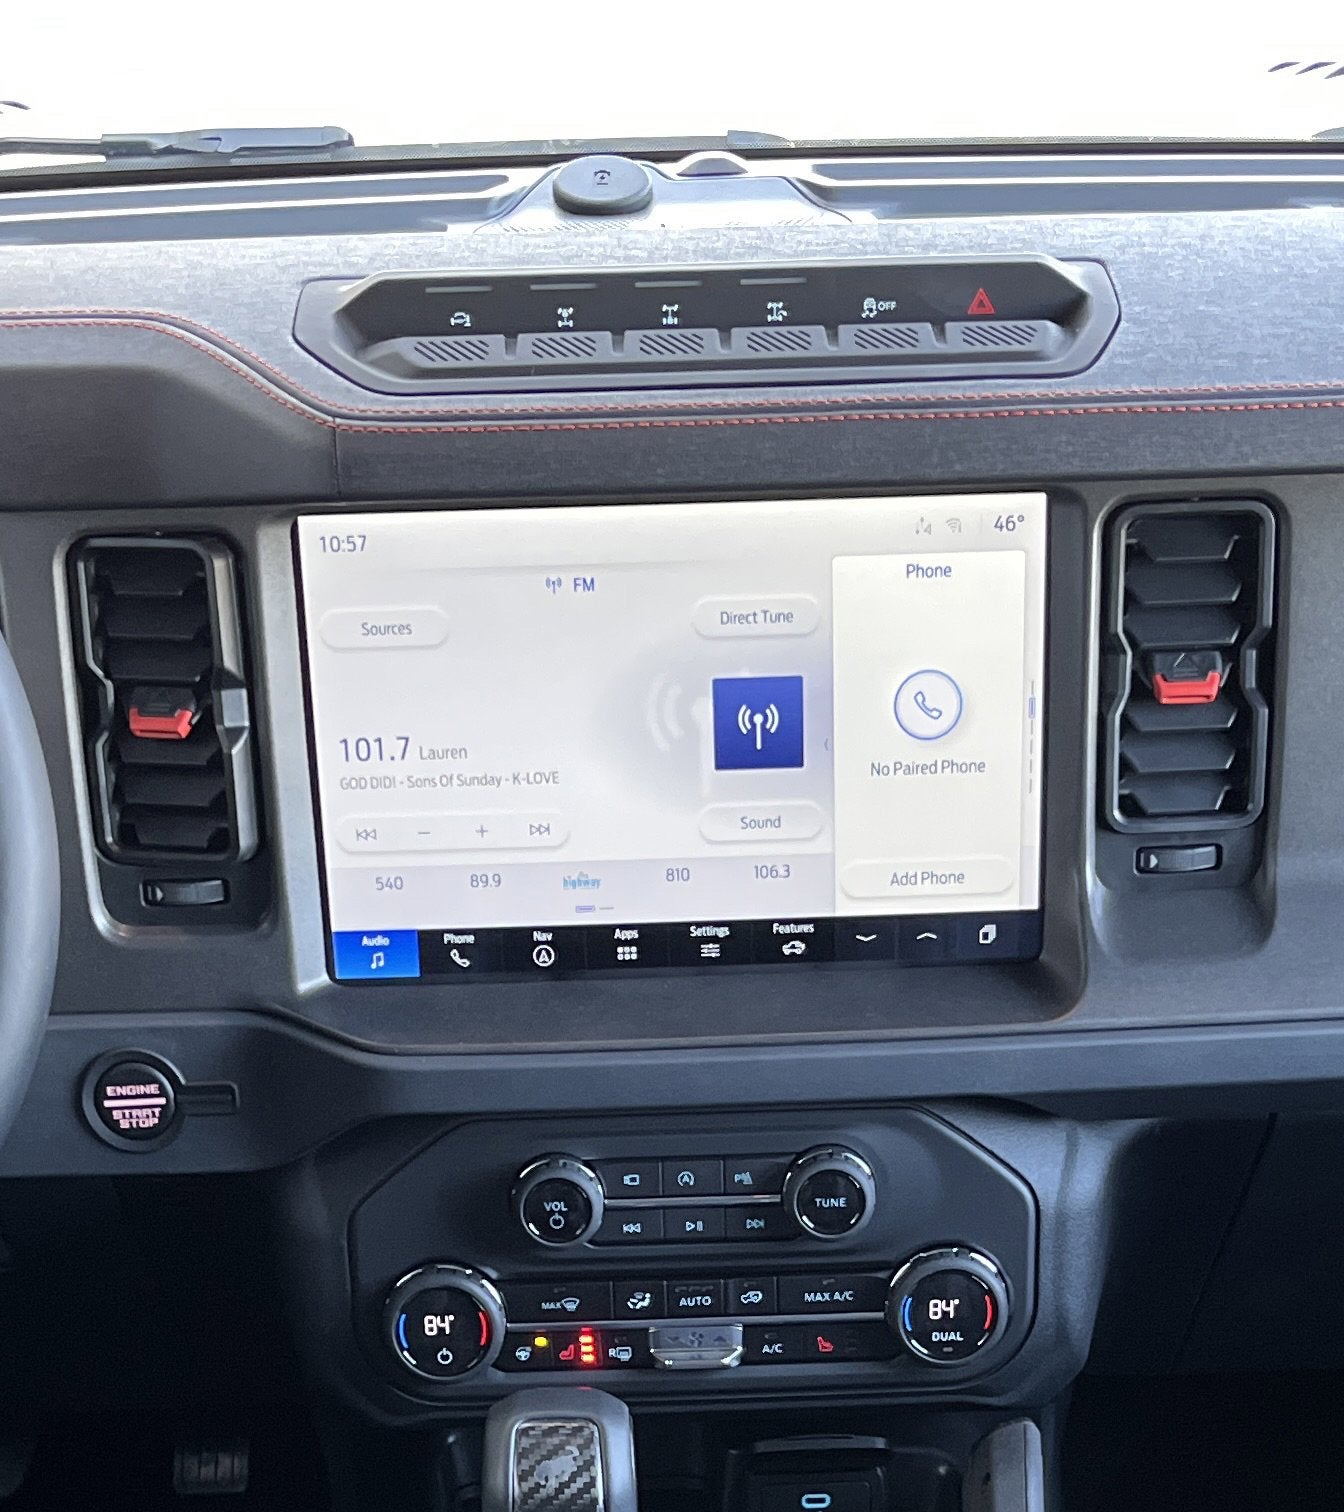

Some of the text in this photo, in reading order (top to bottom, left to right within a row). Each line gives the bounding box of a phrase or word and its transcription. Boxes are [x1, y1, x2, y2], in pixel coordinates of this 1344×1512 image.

[877, 301, 897, 311] OFF
[993, 515, 1025, 533] 46°
[319, 533, 367, 555] 10:57
[905, 563, 952, 579] Phone
[573, 577, 595, 592] FM
[720, 609, 794, 625] Direct Tune
[361, 620, 413, 639] Sources
[339, 736, 468, 762] 101.7 Lauren
[870, 759, 986, 777] No Paired Phone
[340, 776, 368, 790] GOD
[407, 775, 438, 789] Sons
[439, 774, 454, 788] Of
[456, 773, 502, 789] Sunday
[512, 771, 560, 785] K-LOVE
[740, 815, 782, 831] Sound
[666, 867, 690, 883] 810
[754, 864, 791, 880] 106.3
[890, 871, 965, 887] Add Phone
[375, 876, 404, 892] 540
[470, 873, 502, 889] 89.9
[615, 928, 638, 941] Apps
[690, 925, 729, 939] Settings
[773, 922, 814, 935] Features
[362, 936, 389, 947] Audio
[444, 934, 475, 946] Phone
[533, 931, 552, 942] Nav
[106, 1084, 160, 1097] ENGINE
[112, 1107, 162, 1120] START
[119, 1118, 159, 1129] STOP
[543, 1201, 568, 1212] VOL
[814, 1197, 847, 1208] TUNE
[679, 1296, 712, 1306] AUTO
[804, 1291, 854, 1302] MAX A/C
[541, 1301, 562, 1310] MAX
[929, 1298, 960, 1320] 84°
[424, 1314, 455, 1336] 84°
[931, 1331, 964, 1342] DUAL
[762, 1343, 784, 1354] A/C
